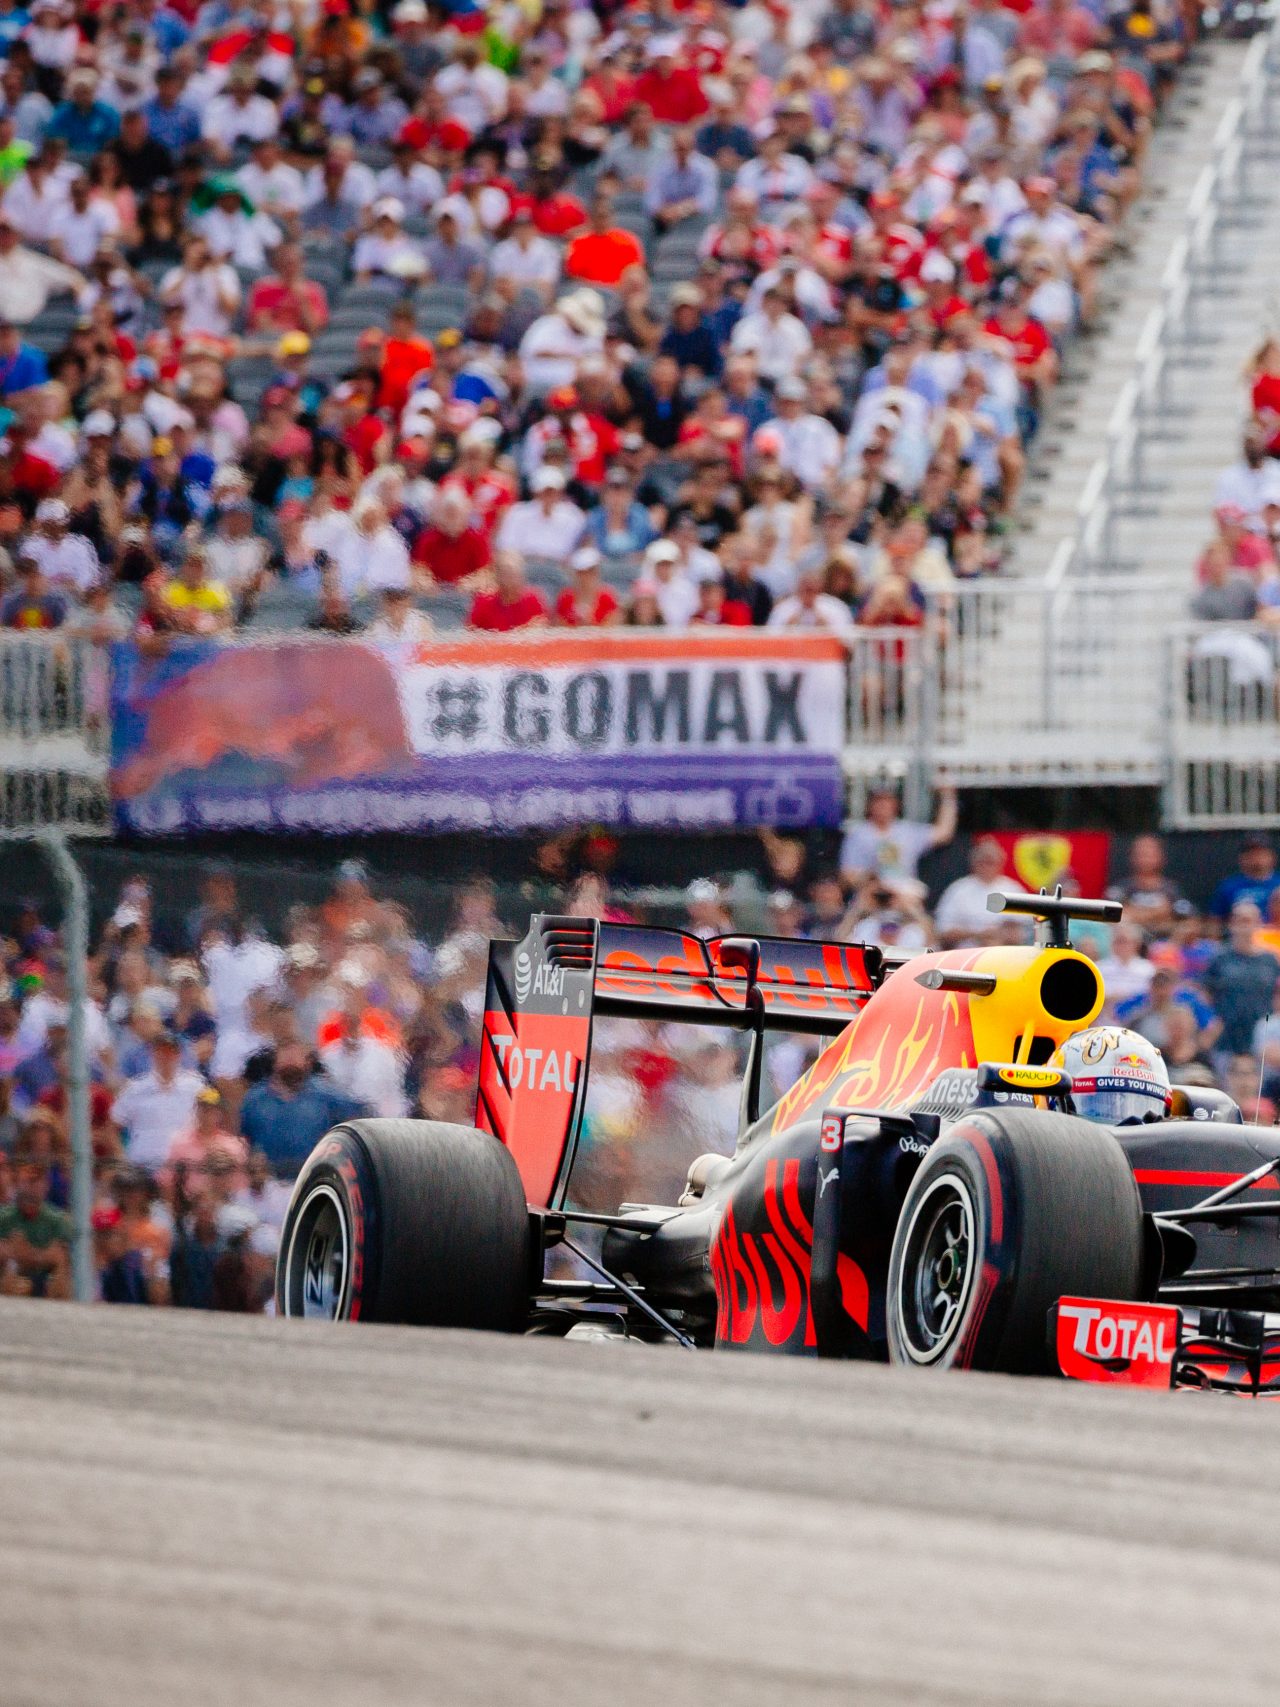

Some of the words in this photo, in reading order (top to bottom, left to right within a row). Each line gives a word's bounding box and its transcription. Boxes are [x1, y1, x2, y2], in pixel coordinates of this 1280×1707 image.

[428, 671, 806, 745] #GOMAX
[533, 964, 568, 996] AT&T
[596, 936, 714, 1000] ed
[491, 1034, 577, 1093] TOTAL
[1015, 1071, 1053, 1081] RAUCH
[1112, 1067, 1135, 1078] Red
[1136, 1069, 1155, 1081] Bull
[923, 1077, 979, 1105] xness
[1011, 1092, 1033, 1103] AT&T
[1097, 1078, 1125, 1087] GIVES
[1128, 1080, 1145, 1090] YOU
[821, 1116, 842, 1152] 3
[899, 1135, 930, 1158] Pep
[1059, 1305, 1174, 1363] TOTAL
